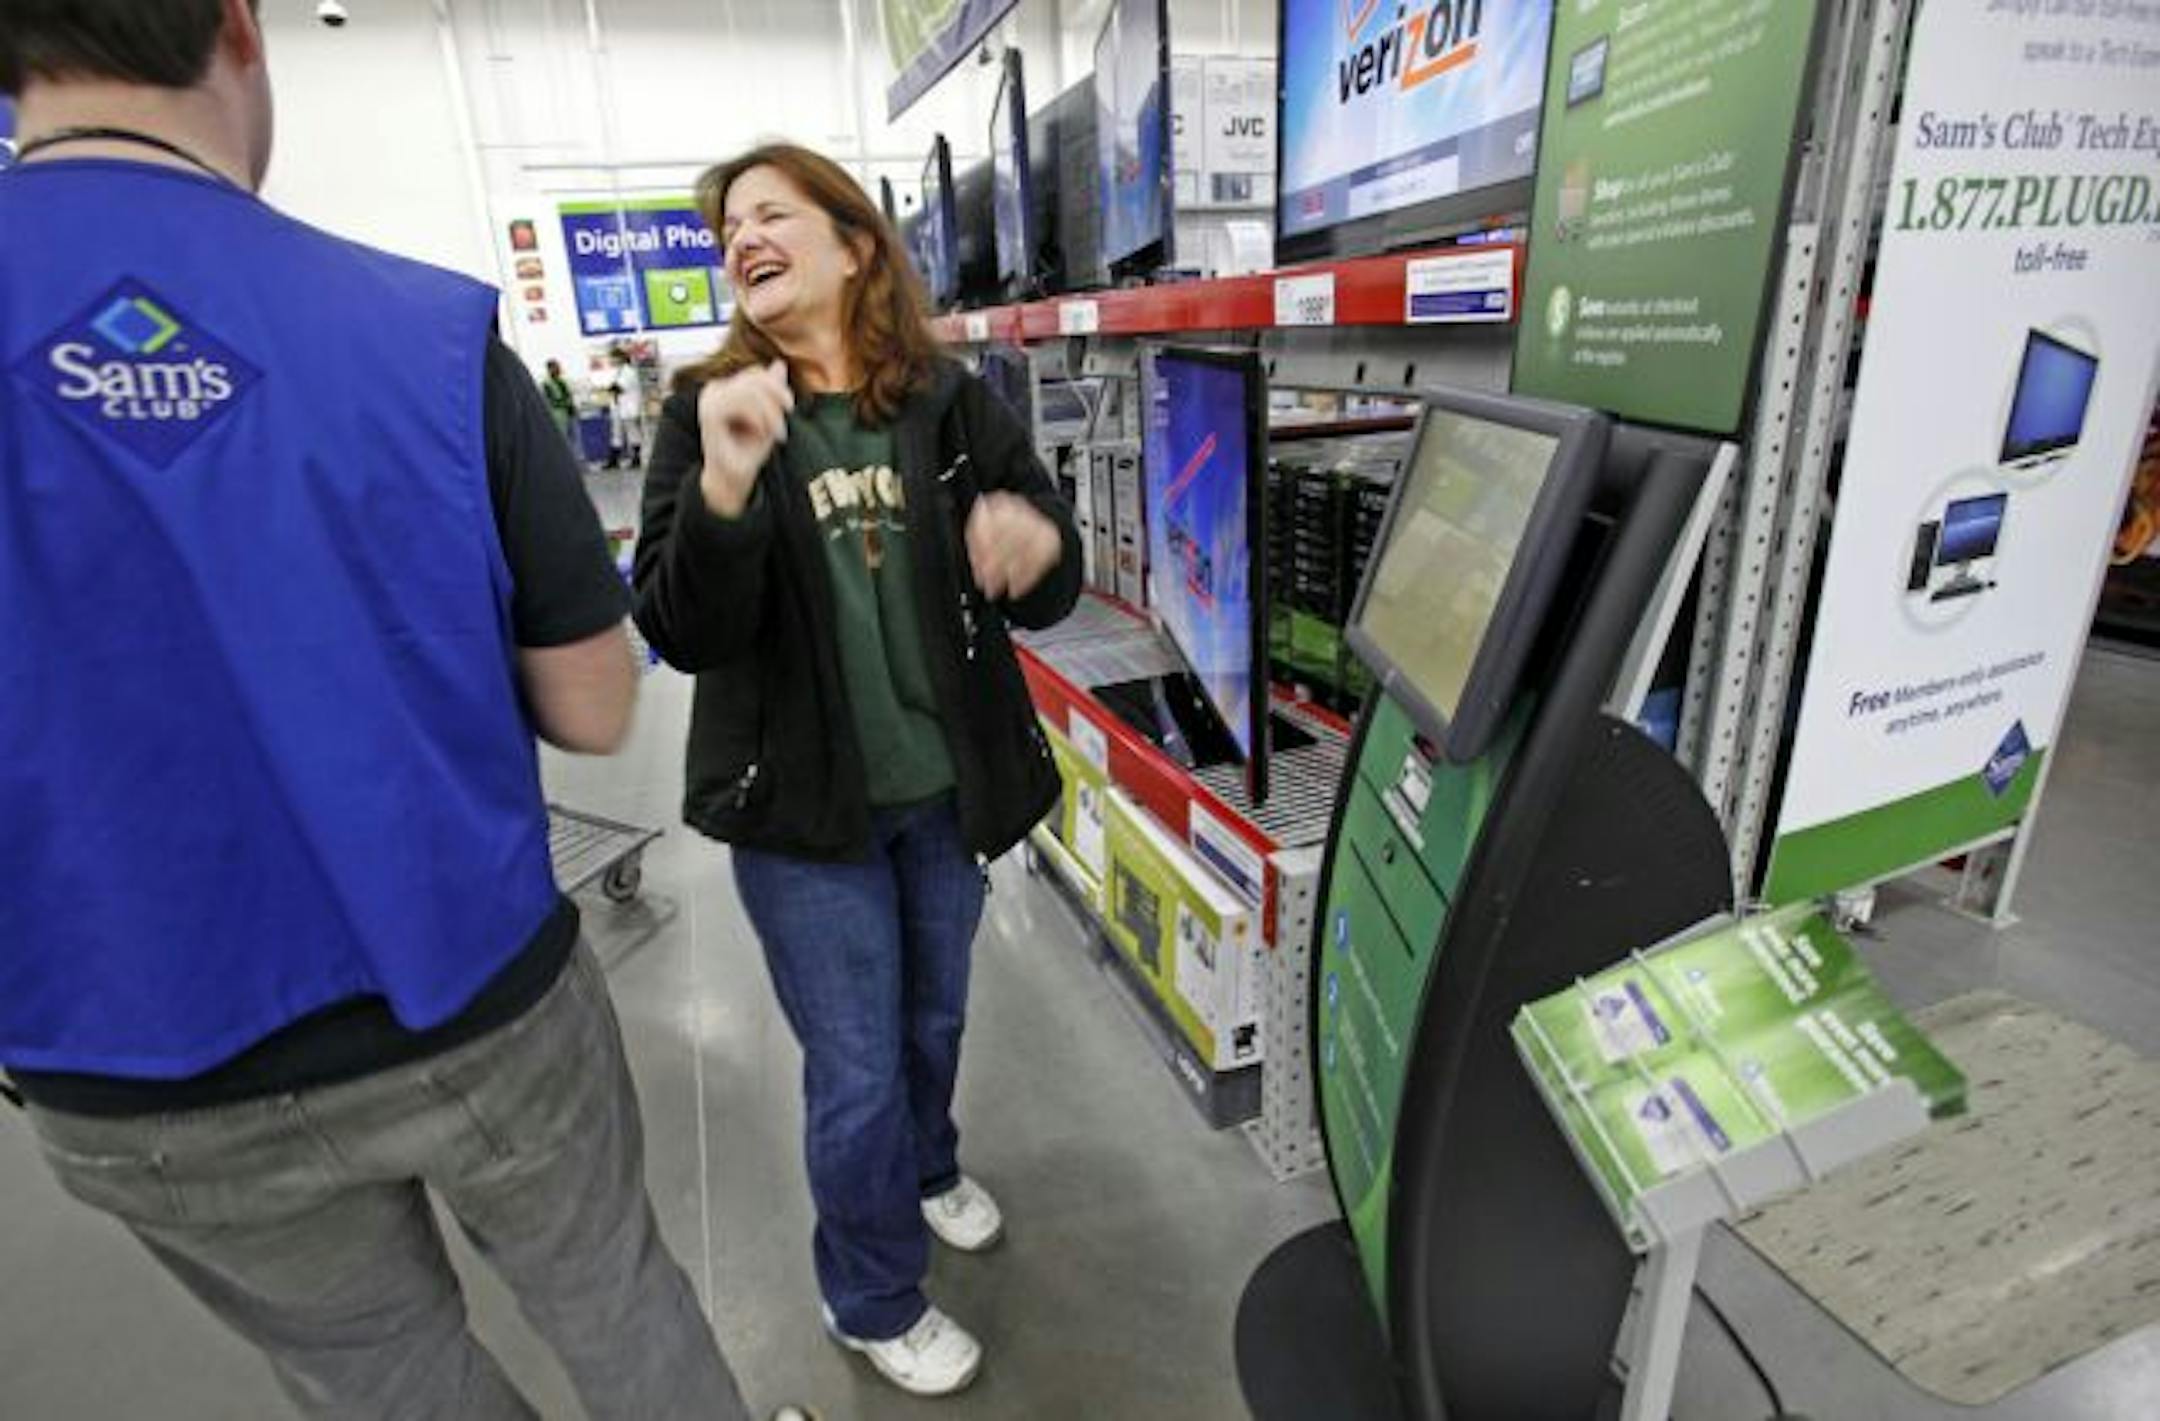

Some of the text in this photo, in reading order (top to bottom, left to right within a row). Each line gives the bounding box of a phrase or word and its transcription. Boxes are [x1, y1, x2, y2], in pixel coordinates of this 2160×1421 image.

[1339, 0, 1482, 104] verizon
[1223, 114, 1265, 137] JVC
[1916, 111, 1998, 150] Sam's
[2003, 109, 2062, 151] Club
[2077, 113, 2130, 150] Tech
[1895, 174, 2160, 231] 1.877.PLUGD.
[575, 221, 715, 258] Digital Pho
[2013, 243, 2089, 273] toll-free
[50, 343, 232, 400] Sam's
[102, 400, 200, 420] CLUB
[1849, 690, 1891, 717] Free
